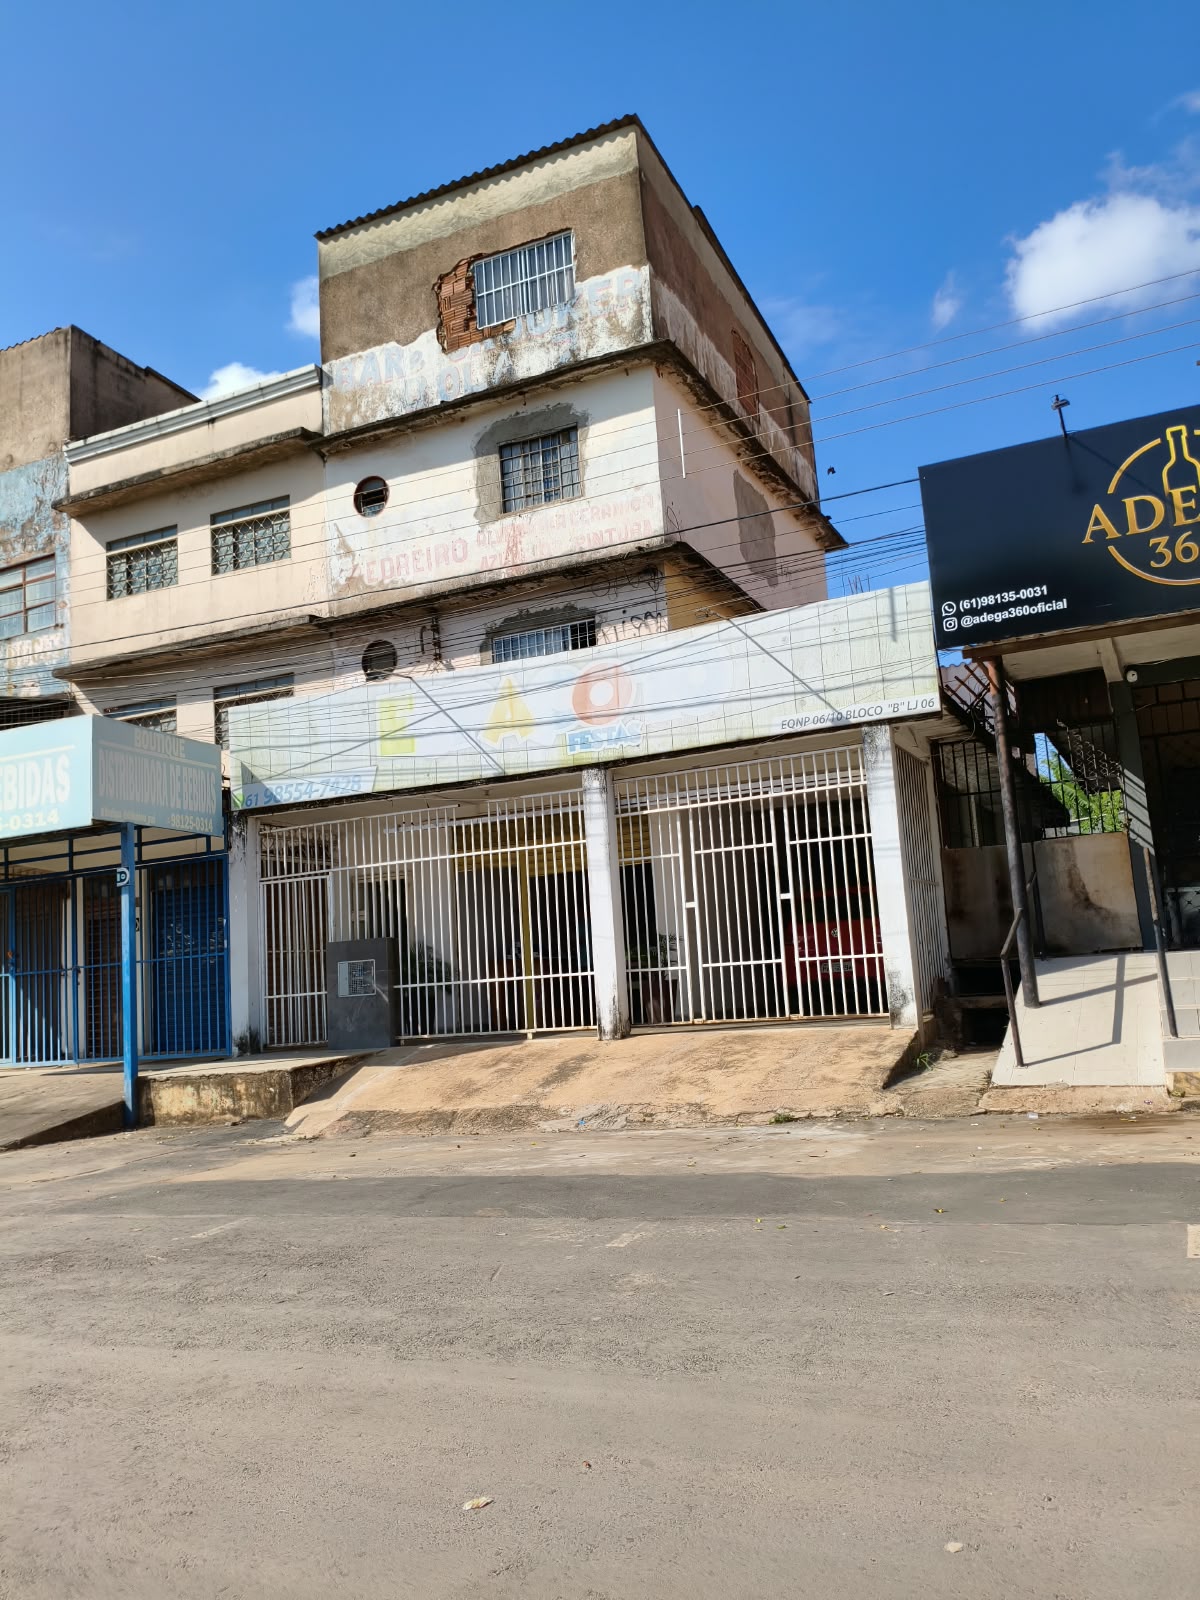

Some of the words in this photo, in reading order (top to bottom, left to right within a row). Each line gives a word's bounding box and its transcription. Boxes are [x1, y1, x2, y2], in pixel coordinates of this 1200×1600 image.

[959, 584, 1048, 613] (61)98135-0031
[961, 599, 1067, 628] @adega360oficial
[781, 716, 812, 730] EQNP
[812, 711, 842, 726] 06/10
[845, 705, 883, 720] BLOCO
[888, 702, 905, 714] "B"
[907, 701, 919, 712] LJ
[921, 698, 935, 709] 06
[133, 729, 186, 758] BOUTIQUE
[567, 722, 643, 753] FESTAS
[98, 748, 168, 806] DISTRIBUIDORA
[170, 763, 181, 809] DE
[183, 766, 217, 815] BEBIDAS
[245, 793, 259, 807] 61
